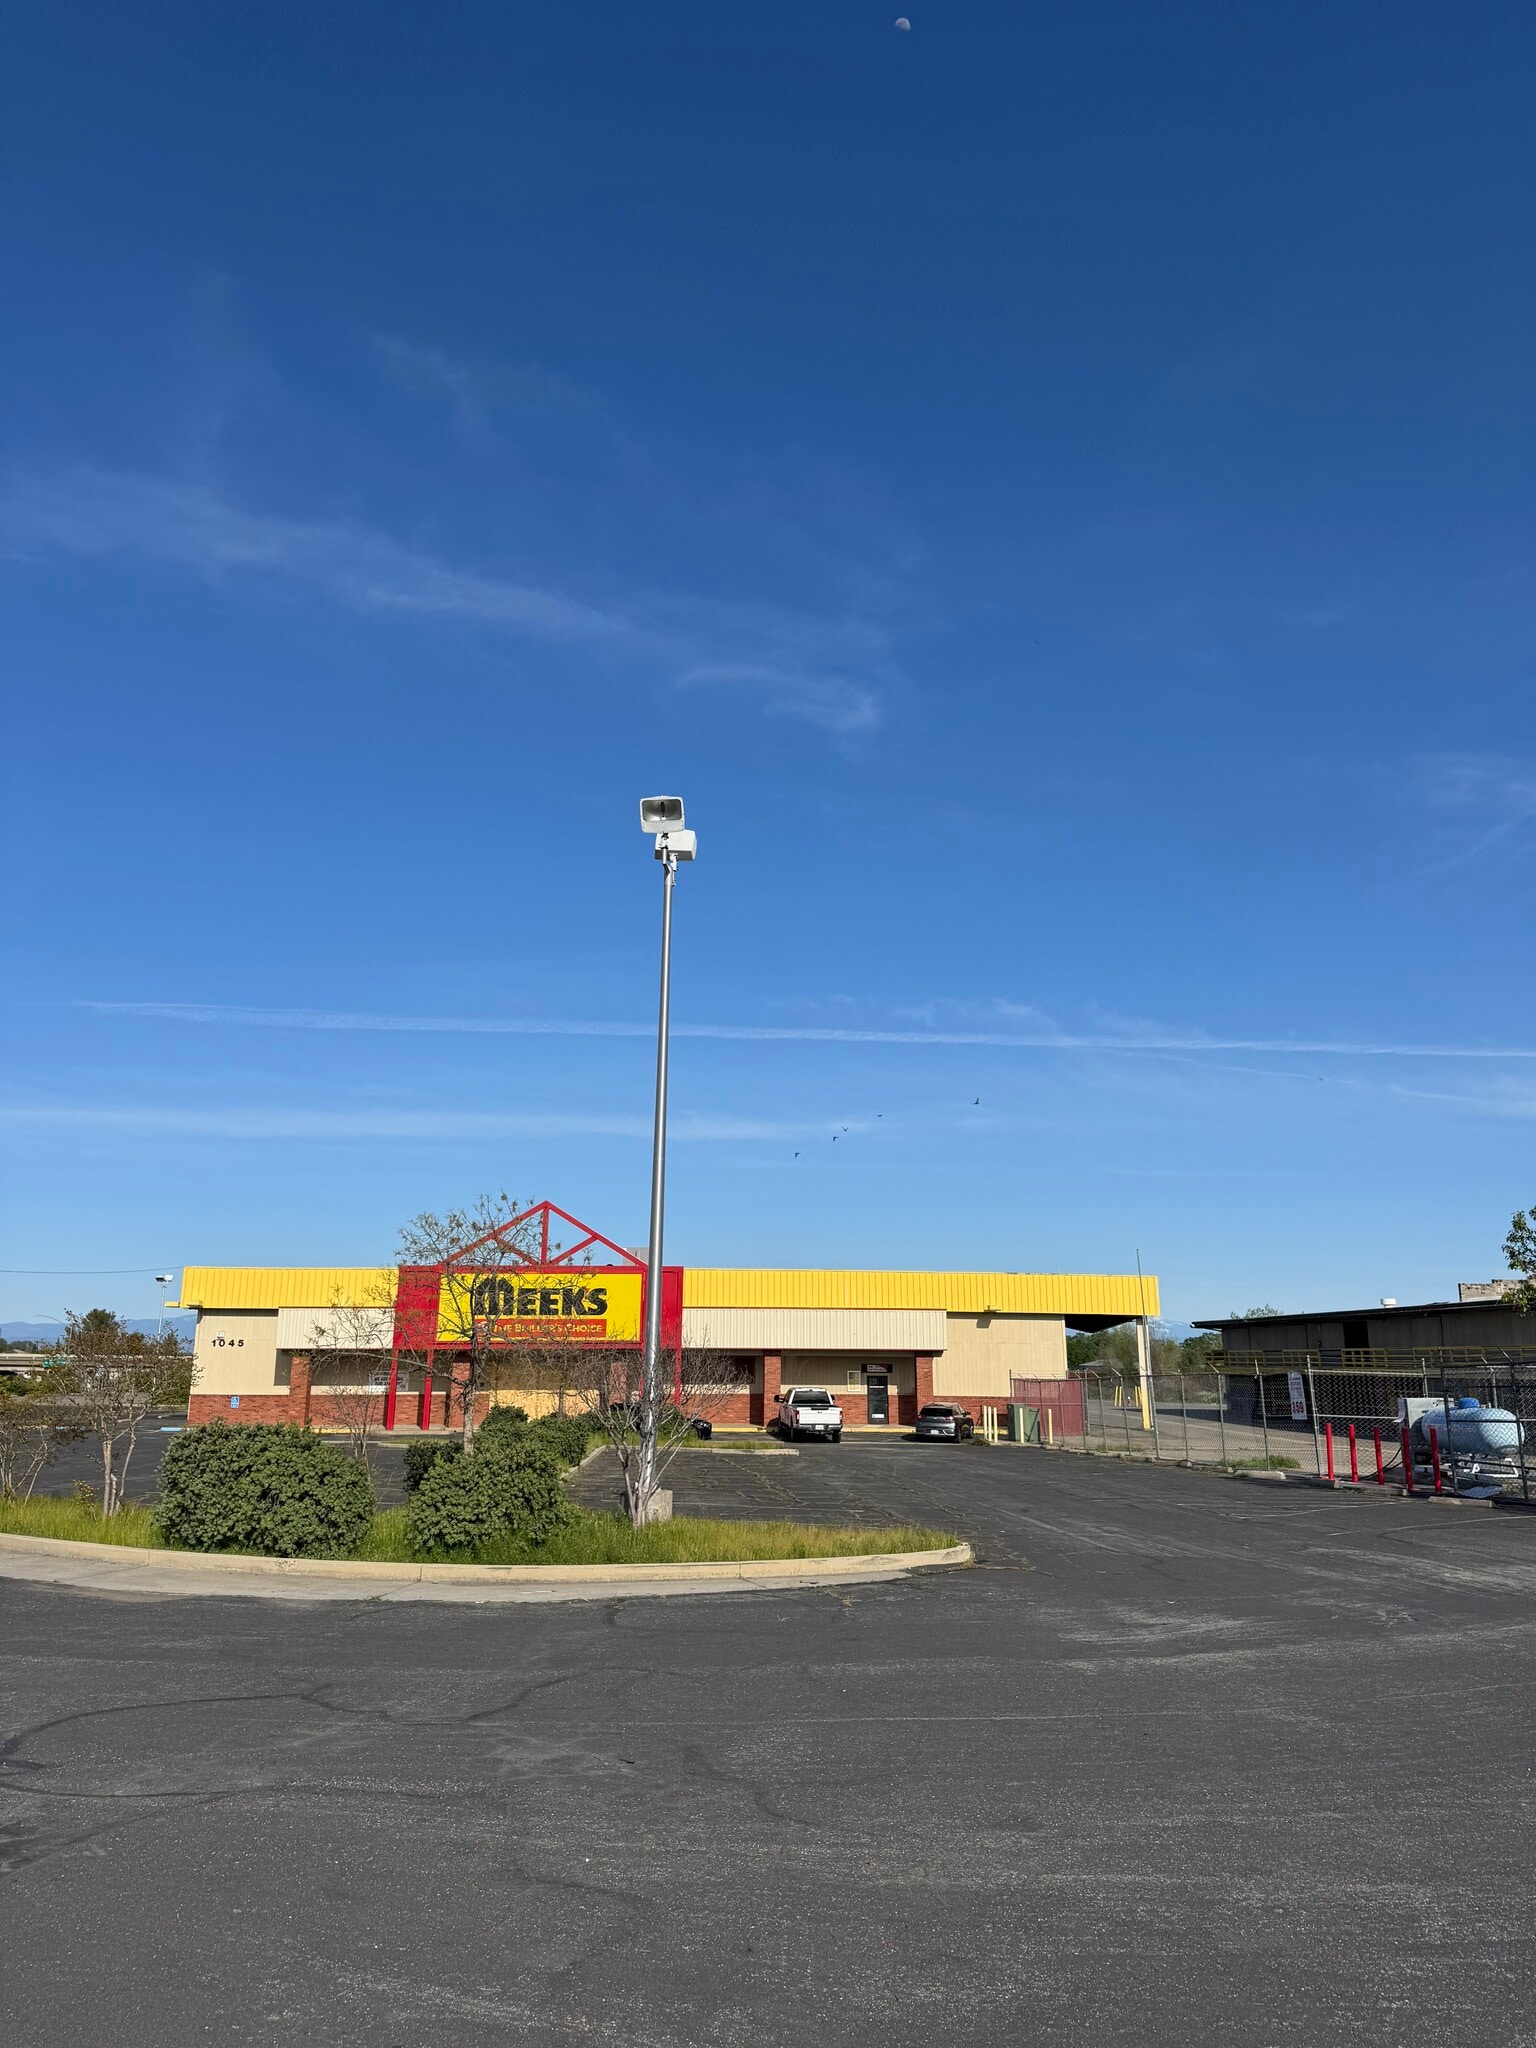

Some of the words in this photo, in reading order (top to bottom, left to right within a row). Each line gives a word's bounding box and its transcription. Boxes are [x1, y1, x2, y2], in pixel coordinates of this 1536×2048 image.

[515, 1323, 562, 1333] BUILR'S
[565, 1323, 602, 1333] CHOICE
[211, 1339, 244, 1347] 1045
